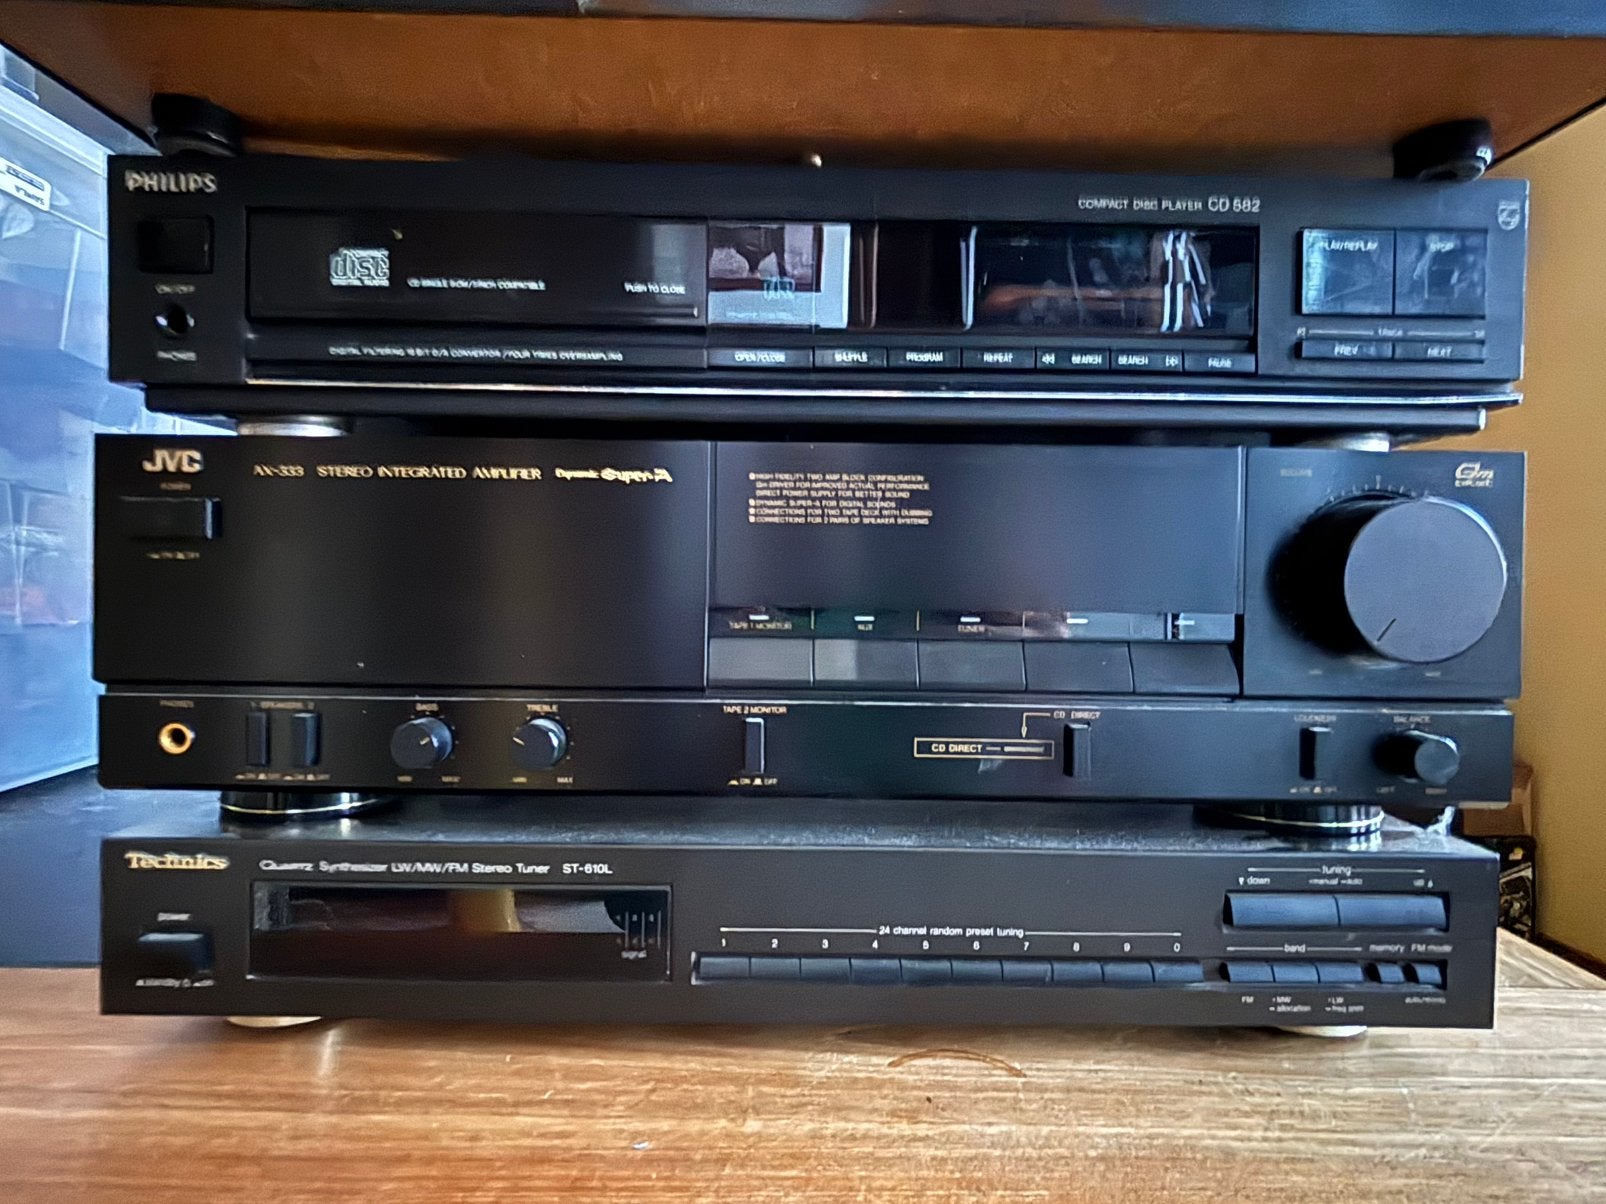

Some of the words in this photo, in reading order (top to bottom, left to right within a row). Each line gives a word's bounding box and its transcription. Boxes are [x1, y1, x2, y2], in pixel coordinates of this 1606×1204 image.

[125, 170, 218, 193] PHILIPS
[1078, 197, 1129, 210] COMPACT
[1133, 198, 1158, 211] DISC
[1162, 199, 1203, 212] PLAYER
[1208, 196, 1230, 212] CD
[624, 282, 647, 293] PUSH
[647, 283, 660, 293] TO
[660, 284, 686, 294] CLOSE
[905, 352, 944, 362] PROGRAM
[983, 352, 1014, 363] REPEAT
[1071, 354, 1102, 365] SEARCH
[1118, 355, 1149, 366] SEARCH
[142, 449, 205, 474] JVC
[316, 465, 374, 478] STEREO
[376, 465, 467, 479] INTEGRATED
[472, 466, 542, 480] AMPLIFIER
[775, 473, 805, 481] FIDELITY
[806, 473, 823, 481] TWO
[782, 489, 809, 497] POWER
[723, 706, 743, 715] TAPE
[750, 706, 788, 715] MONITOR
[1053, 711, 1066, 720] CD
[1070, 711, 1101, 721] DIRECT
[931, 743, 946, 753] CD
[948, 743, 983, 754] DIRECT
[124, 852, 229, 871] Technics
[390, 861, 469, 874] LW/MW/FM
[471, 861, 513, 875] Stereo
[515, 863, 550, 875] Tuner
[561, 863, 614, 875] ST-610L
[1321, 864, 1352, 877] tuning
[1246, 876, 1271, 885] down
[878, 926, 891, 936] 24
[892, 926, 928, 937] channel
[929, 926, 965, 938] random
[965, 928, 995, 939] preset
[996, 927, 1025, 940] tuning
[771, 939, 779, 949] 2
[821, 939, 830, 950] 3
[871, 940, 880, 950] 4
[1023, 942, 1030, 951] 7
[1173, 943, 1182, 952] 0
[1284, 943, 1307, 953] band
